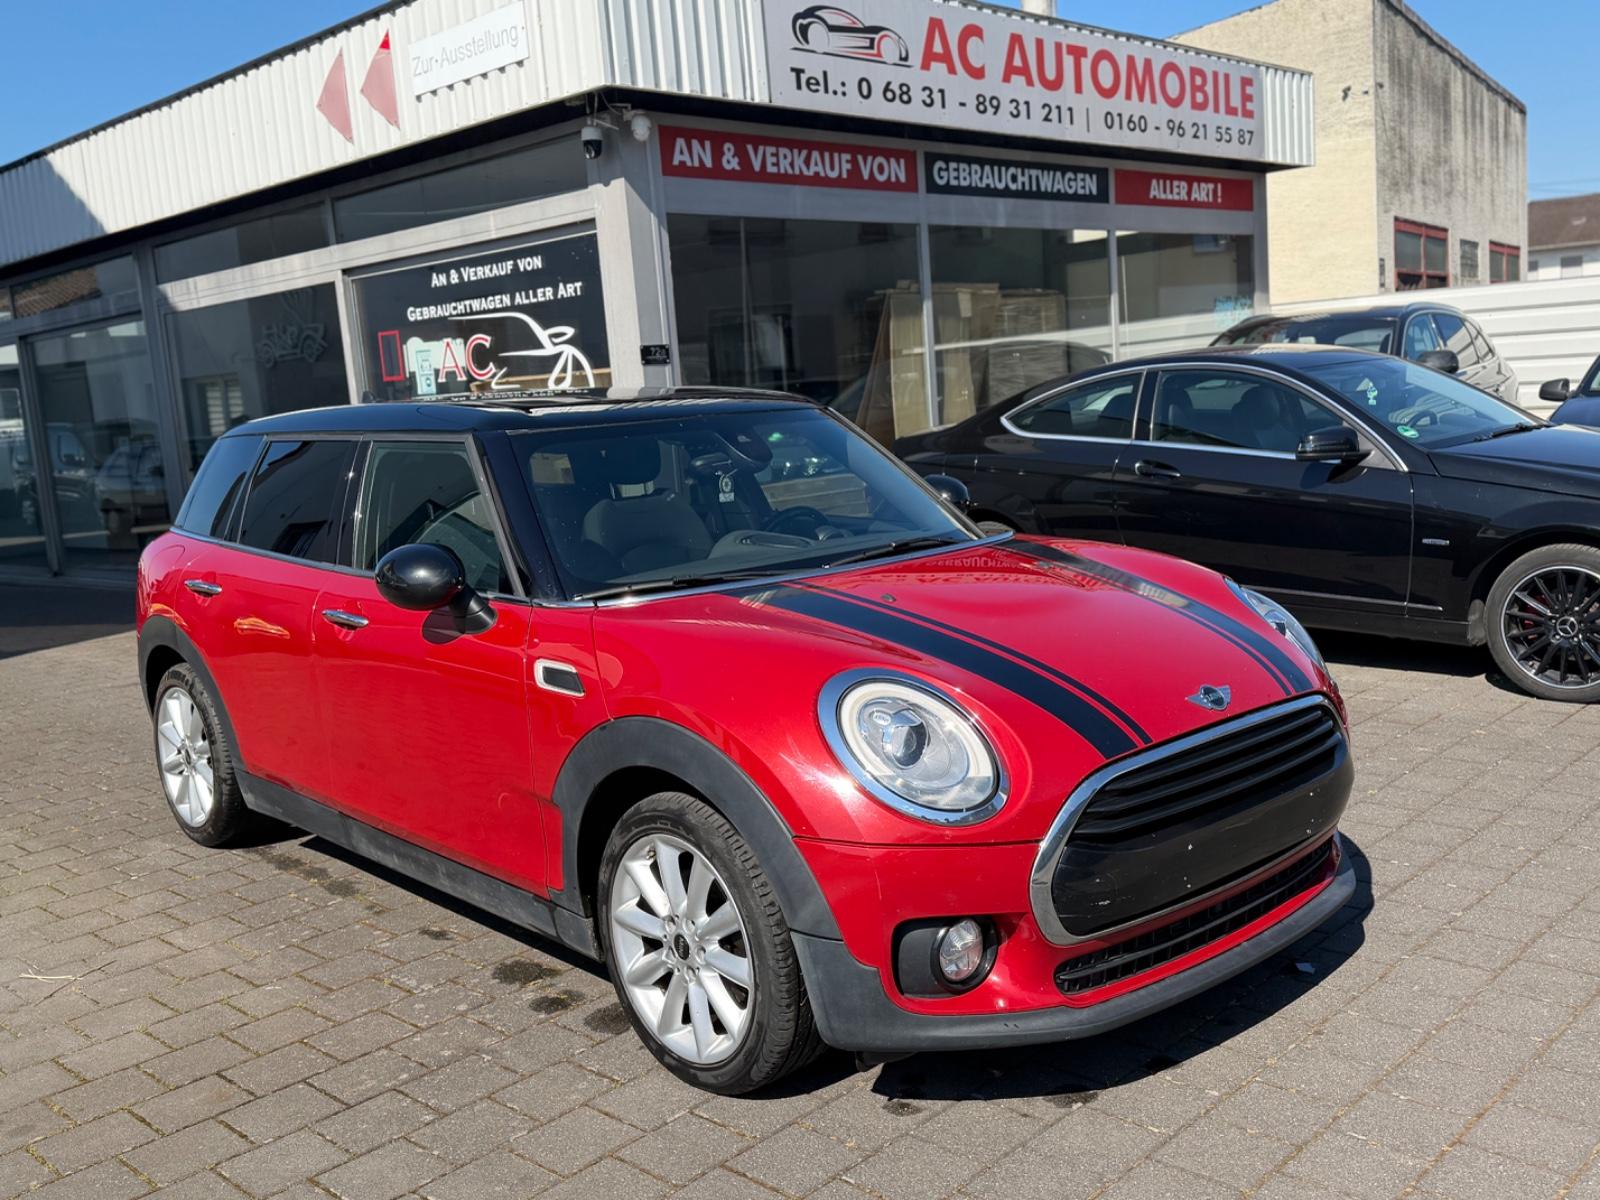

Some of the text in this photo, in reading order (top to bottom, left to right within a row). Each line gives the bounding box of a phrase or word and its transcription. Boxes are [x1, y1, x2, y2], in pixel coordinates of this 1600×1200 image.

[412, 25, 519, 77] Zur Ausstellung
[920, 16, 1255, 119] AC AUTOMOBILE
[790, 67, 847, 97] Tel.:
[857, 77, 872, 99] 0
[882, 80, 912, 104] 68
[921, 86, 946, 109] 31
[975, 94, 1000, 116] 89
[1009, 98, 1031, 120] 31
[1041, 103, 1074, 125] 211
[1104, 111, 1148, 133] 0160
[1167, 119, 1186, 138] 96
[1191, 123, 1208, 140] 21
[1215, 126, 1232, 143] 55
[1237, 129, 1255, 146] 87
[672, 137, 906, 183] AN & VERKAUF VON
[932, 160, 1097, 195] GEBRAUCHTWAGEN
[1149, 178, 1188, 201] ALLER
[1190, 182, 1216, 202] ART
[449, 269, 459, 284] &
[514, 287, 554, 305] ALLER
[437, 333, 496, 383] AC
